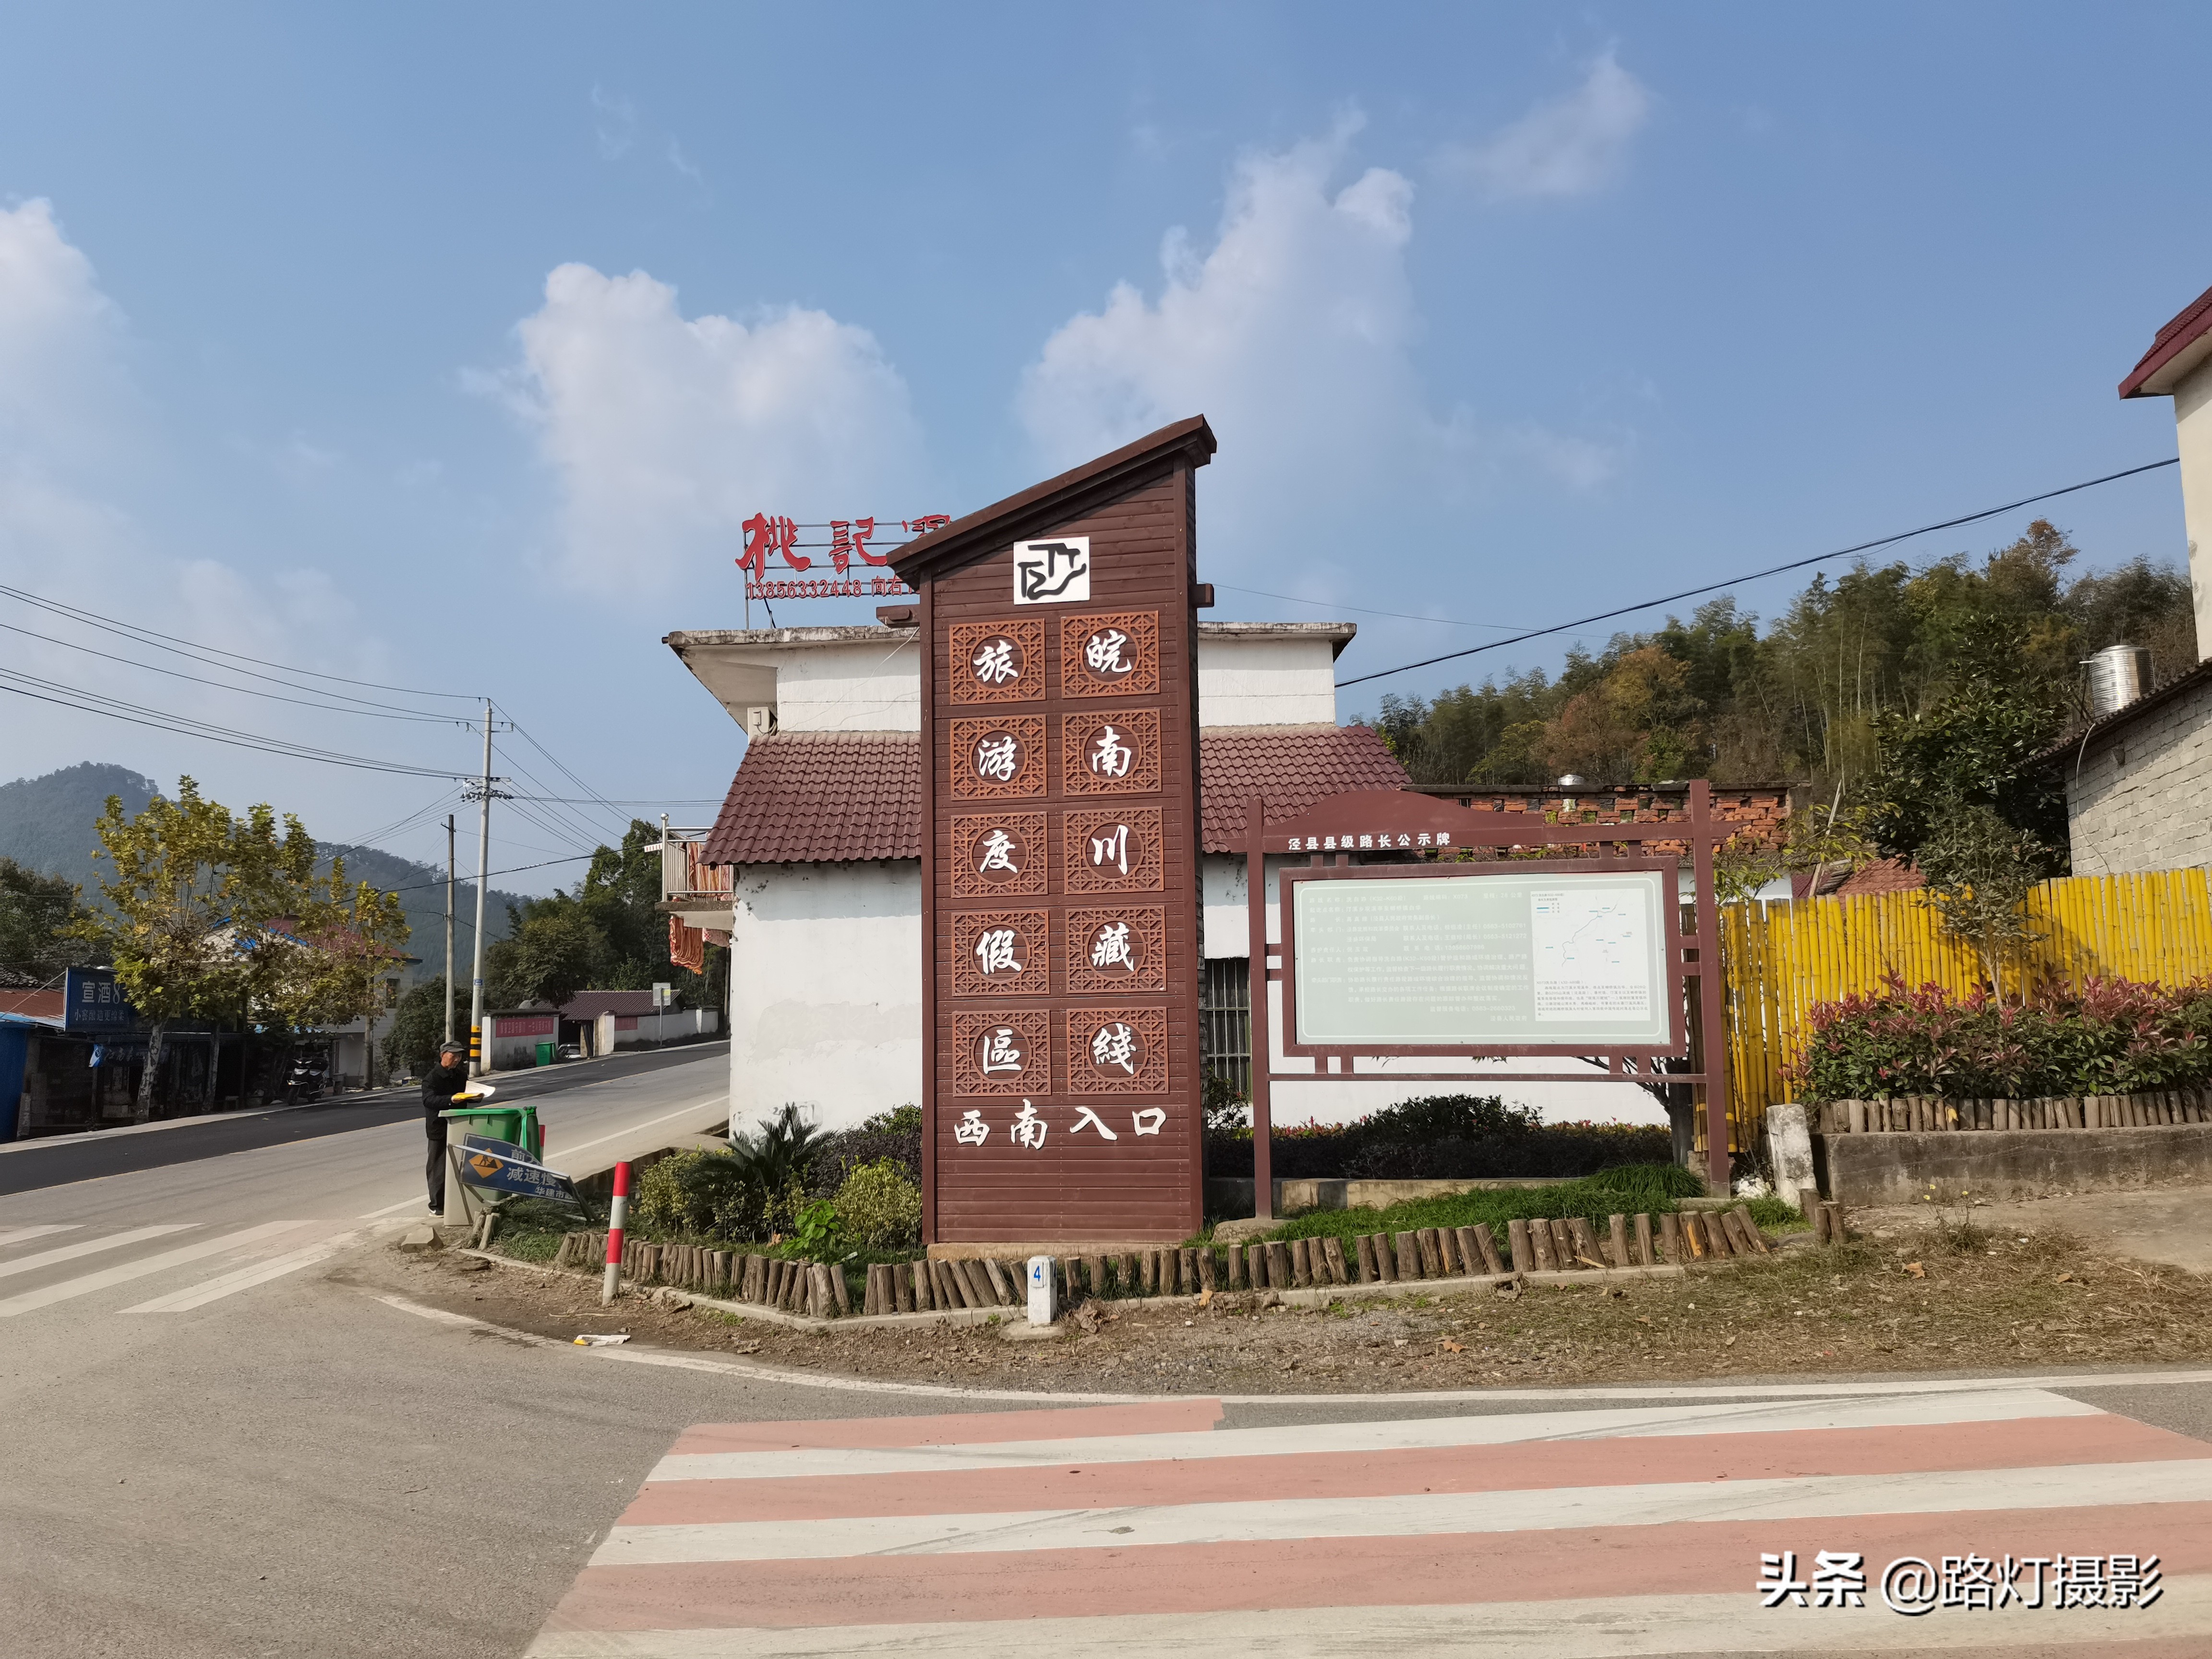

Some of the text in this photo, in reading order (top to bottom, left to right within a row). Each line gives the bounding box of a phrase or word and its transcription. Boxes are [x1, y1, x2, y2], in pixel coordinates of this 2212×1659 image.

[746, 575, 920, 599] 13856332448 向右
[1288, 832, 1451, 850] 泾县县级路长公示牌
[954, 1098, 1166, 1150] 西南入口
[506, 1166, 562, 1188] 减速慢
[1034, 1265, 1041, 1282] 4
